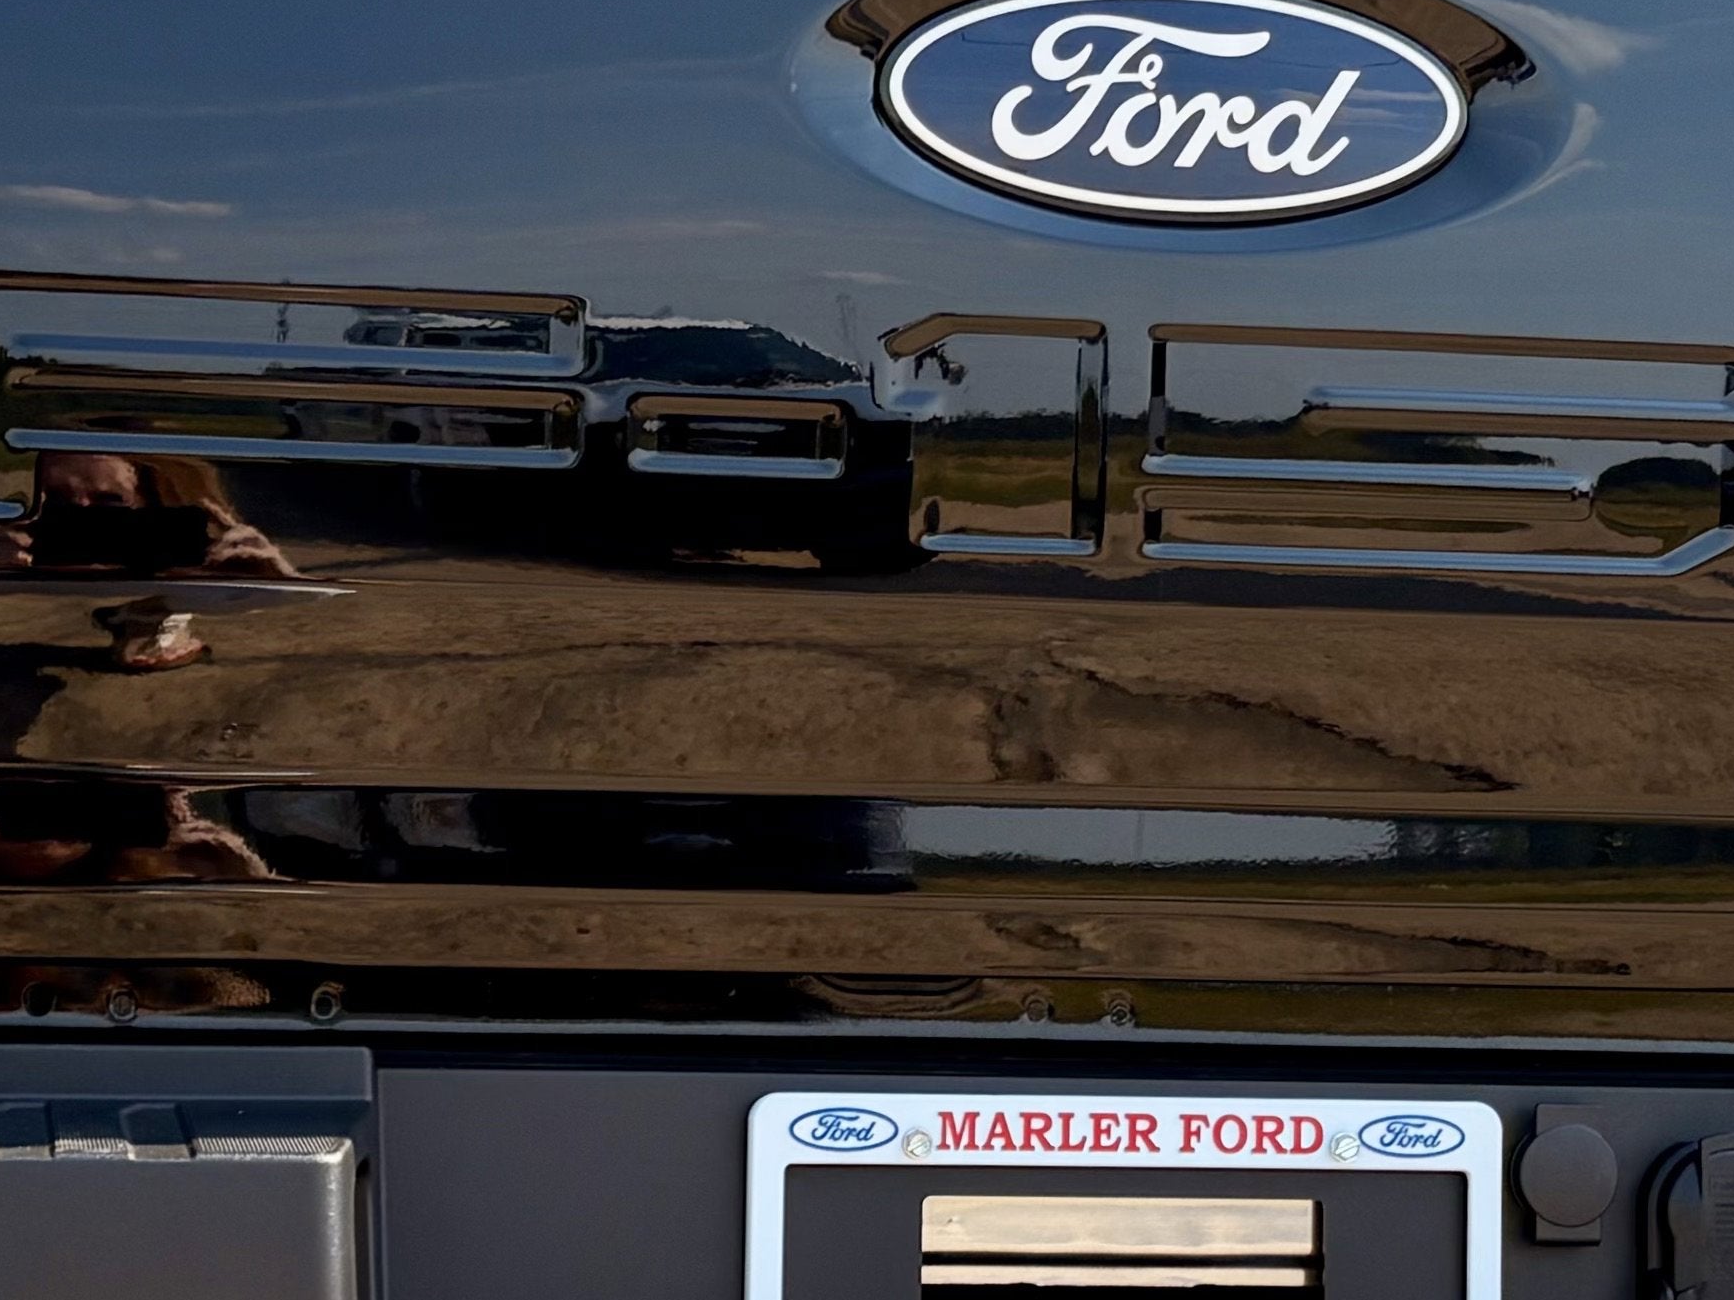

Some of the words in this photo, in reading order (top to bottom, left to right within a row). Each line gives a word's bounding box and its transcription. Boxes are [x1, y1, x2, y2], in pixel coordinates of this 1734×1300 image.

[992, 13, 1361, 176] Ford
[810, 1114, 875, 1143] Ford
[936, 1110, 1161, 1153] MARLER
[1178, 1113, 1324, 1156] FORD
[1378, 1121, 1441, 1149] Ford
